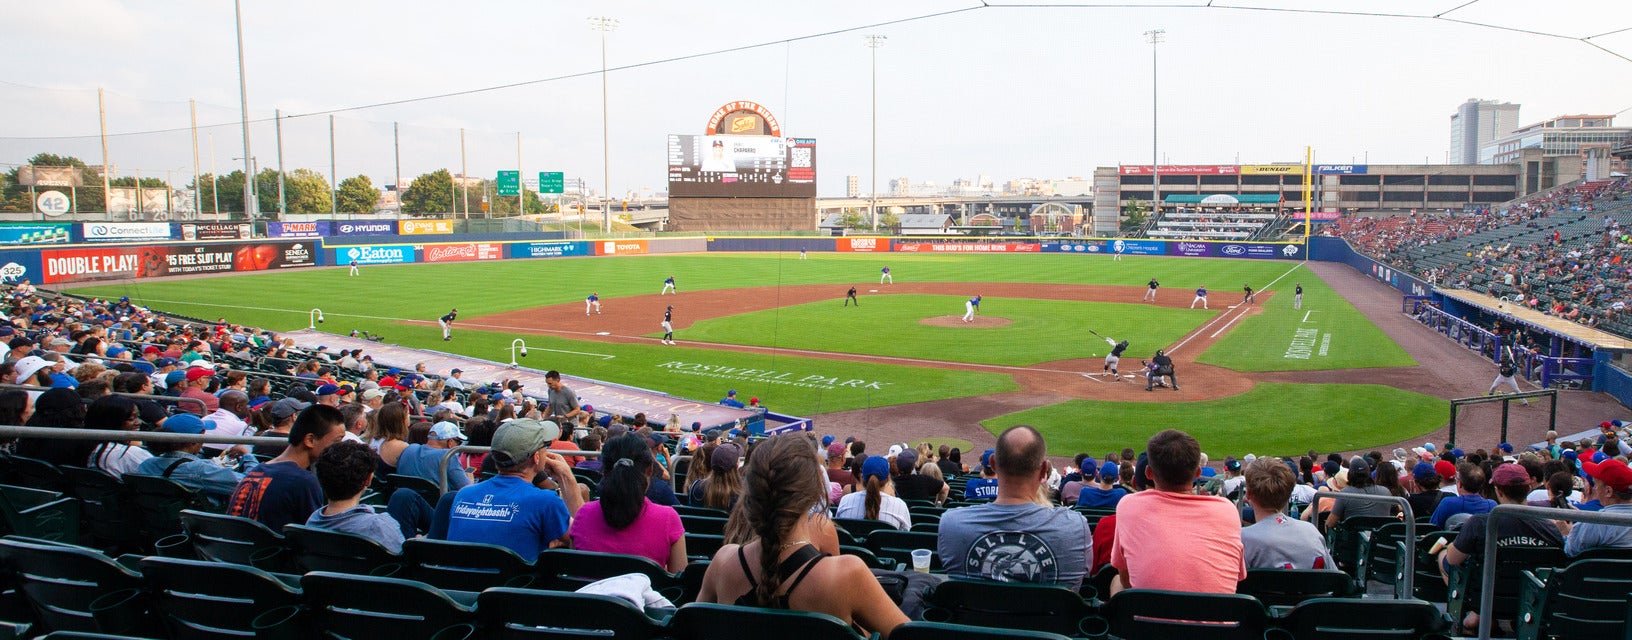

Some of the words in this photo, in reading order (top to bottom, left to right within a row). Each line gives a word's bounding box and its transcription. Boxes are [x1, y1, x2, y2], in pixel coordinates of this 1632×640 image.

[709, 109, 727, 130] HOME
[726, 103, 737, 113] OF
[739, 102, 756, 110] THE
[43, 197, 64, 211] 42
[153, 208, 168, 221] 25
[180, 207, 196, 221] 30
[355, 224, 391, 233] HYUNDAI
[361, 247, 404, 259] Eaton
[1225, 246, 1241, 254] Ford
[49, 256, 100, 276] DOUBLE
[103, 254, 139, 273] PLAY!
[165, 254, 177, 266] $15
[178, 254, 196, 265] FREE
[198, 253, 214, 264] SLOT
[215, 252, 232, 263] PLAY
[3, 265, 22, 275] 325
[656, 361, 793, 380] ROSWELL
[799, 375, 894, 390] PARK
[1497, 536, 1549, 547] WHISKE
[974, 533, 1007, 568] SALT
